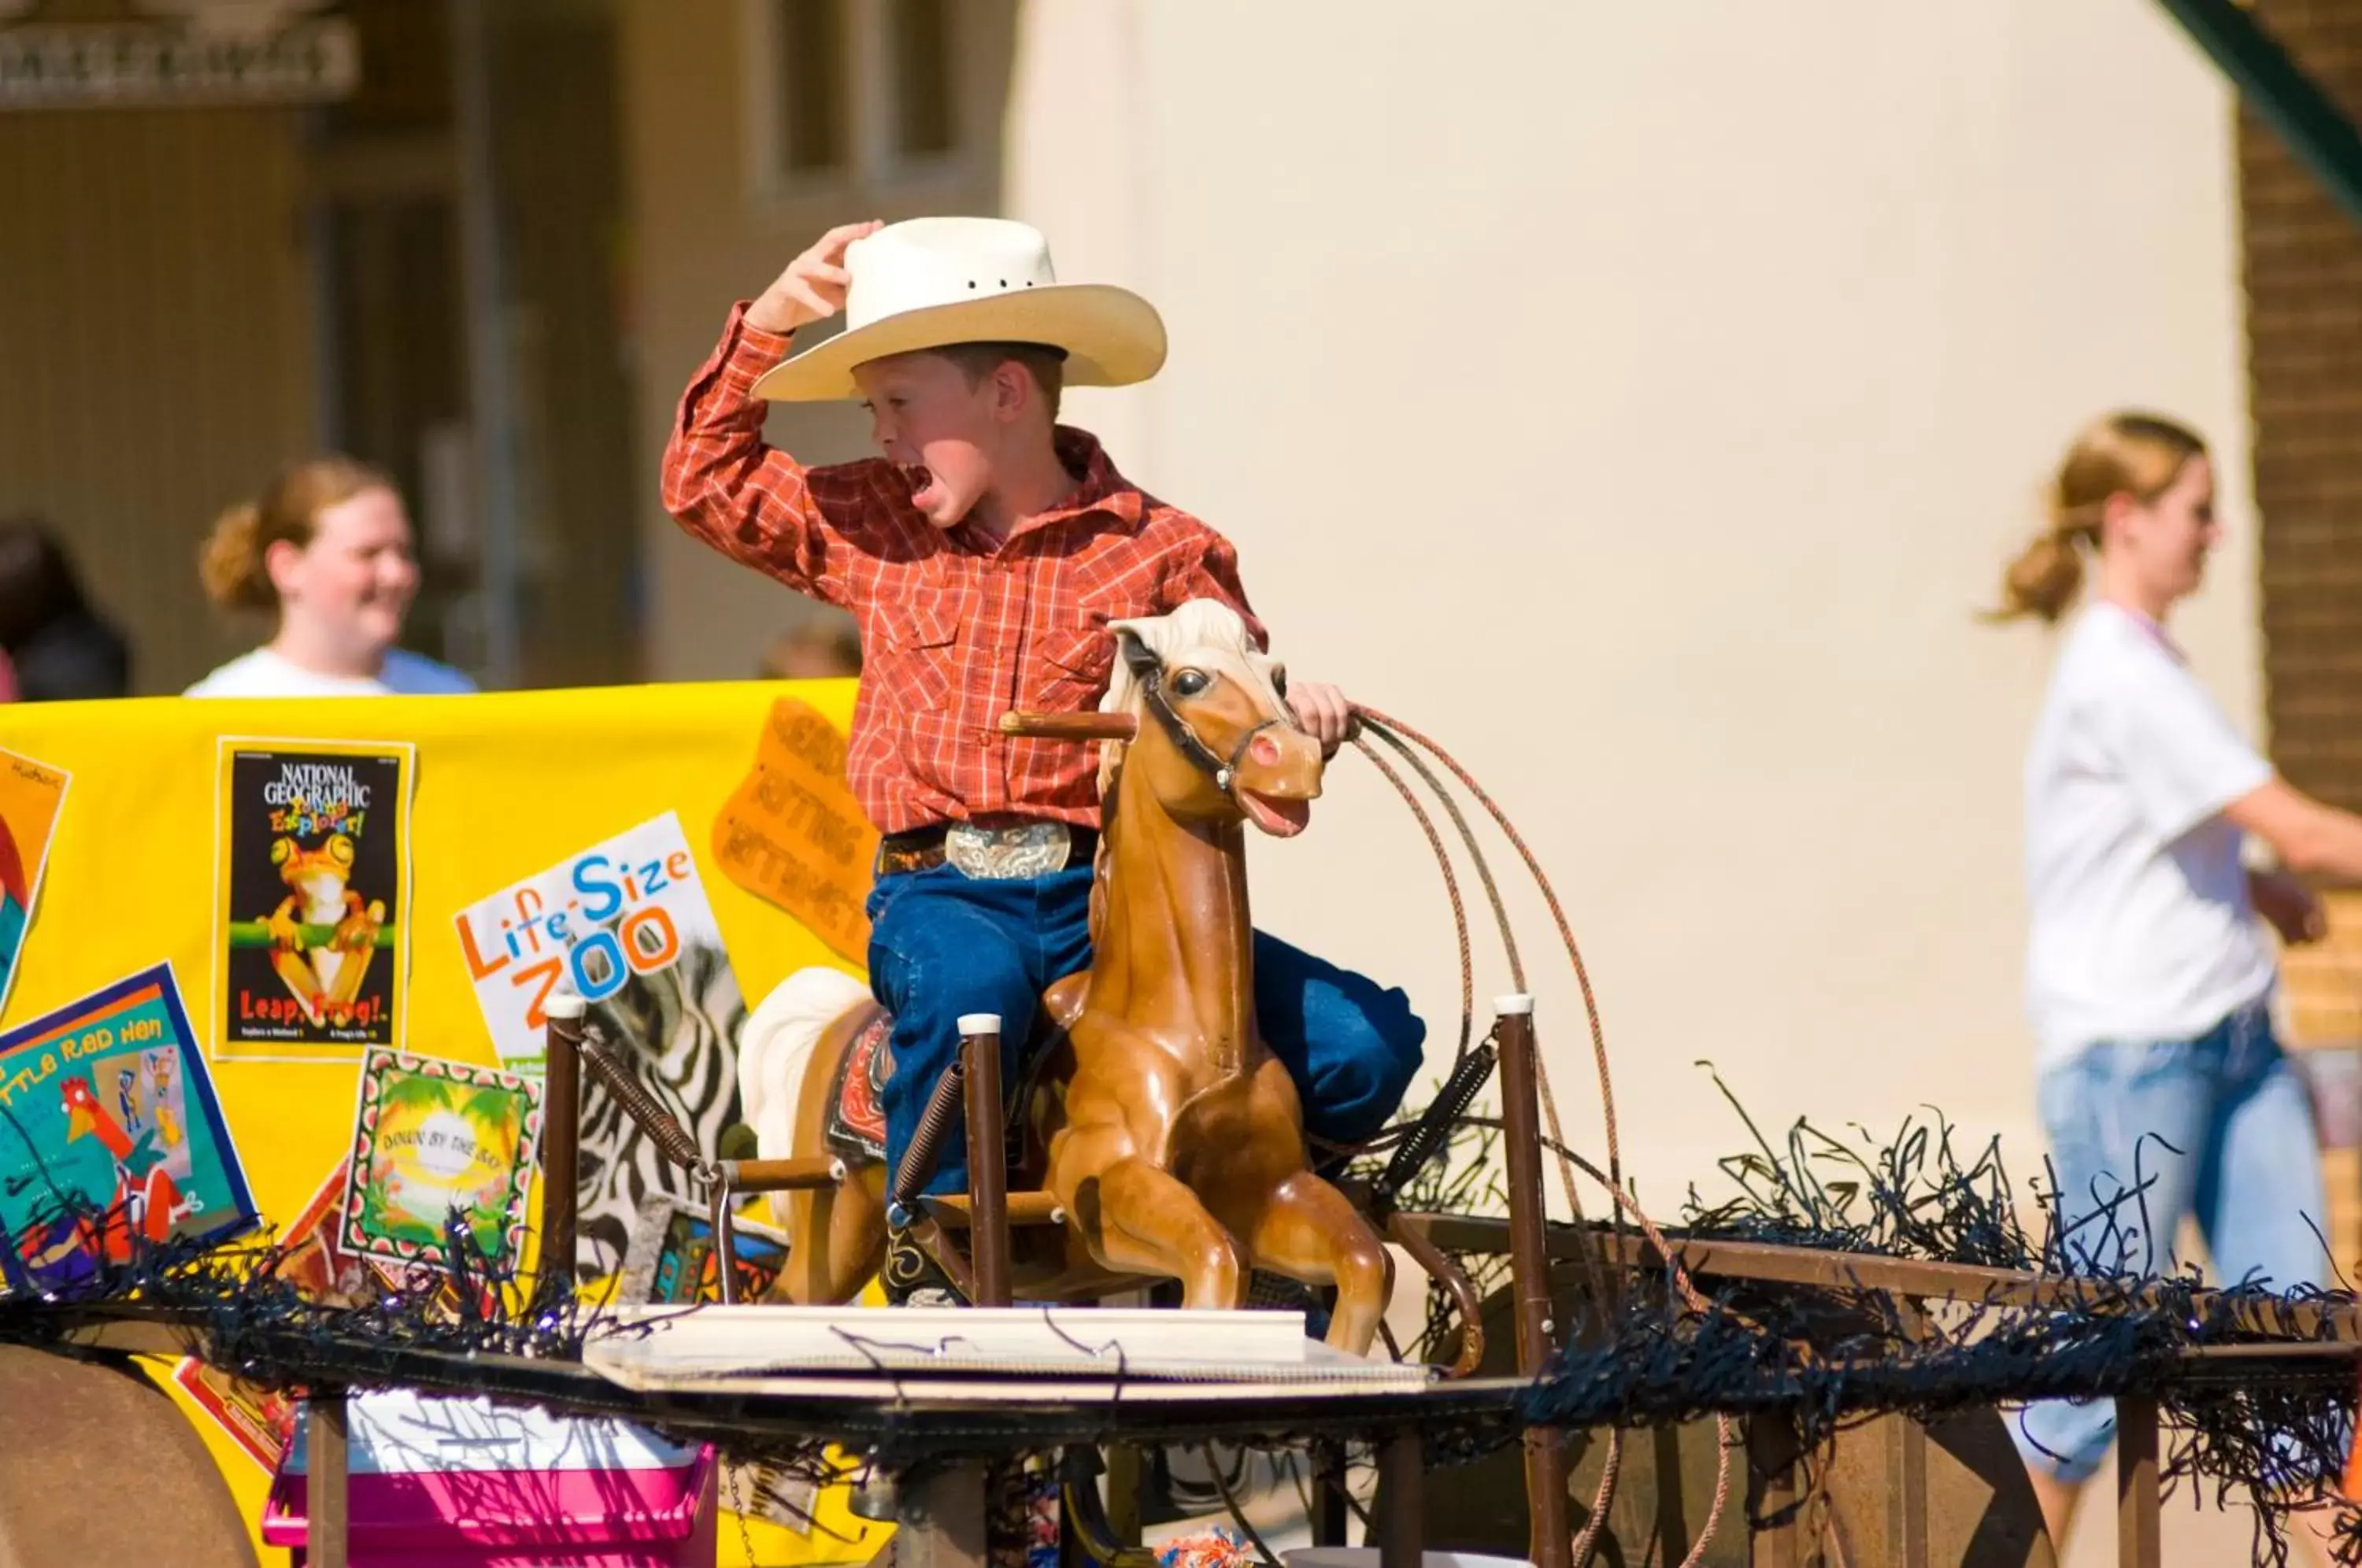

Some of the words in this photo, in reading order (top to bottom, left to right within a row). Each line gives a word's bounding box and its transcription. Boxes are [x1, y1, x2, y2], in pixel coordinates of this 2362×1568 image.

[281, 762, 354, 788] NATIONAL
[264, 781, 371, 809] GEOGRAPHIC
[291, 796, 350, 816] Young
[268, 810, 366, 839] Explorer!
[454, 850, 690, 982] Life-Size
[510, 905, 679, 1031] ZOO
[240, 989, 305, 1026] Leap,
[312, 992, 380, 1028] Frog!
[383, 1128, 426, 1152] DOWN
[428, 1130, 448, 1148] BY
[450, 1135, 477, 1158] THE
[475, 1147, 502, 1169] BAY
